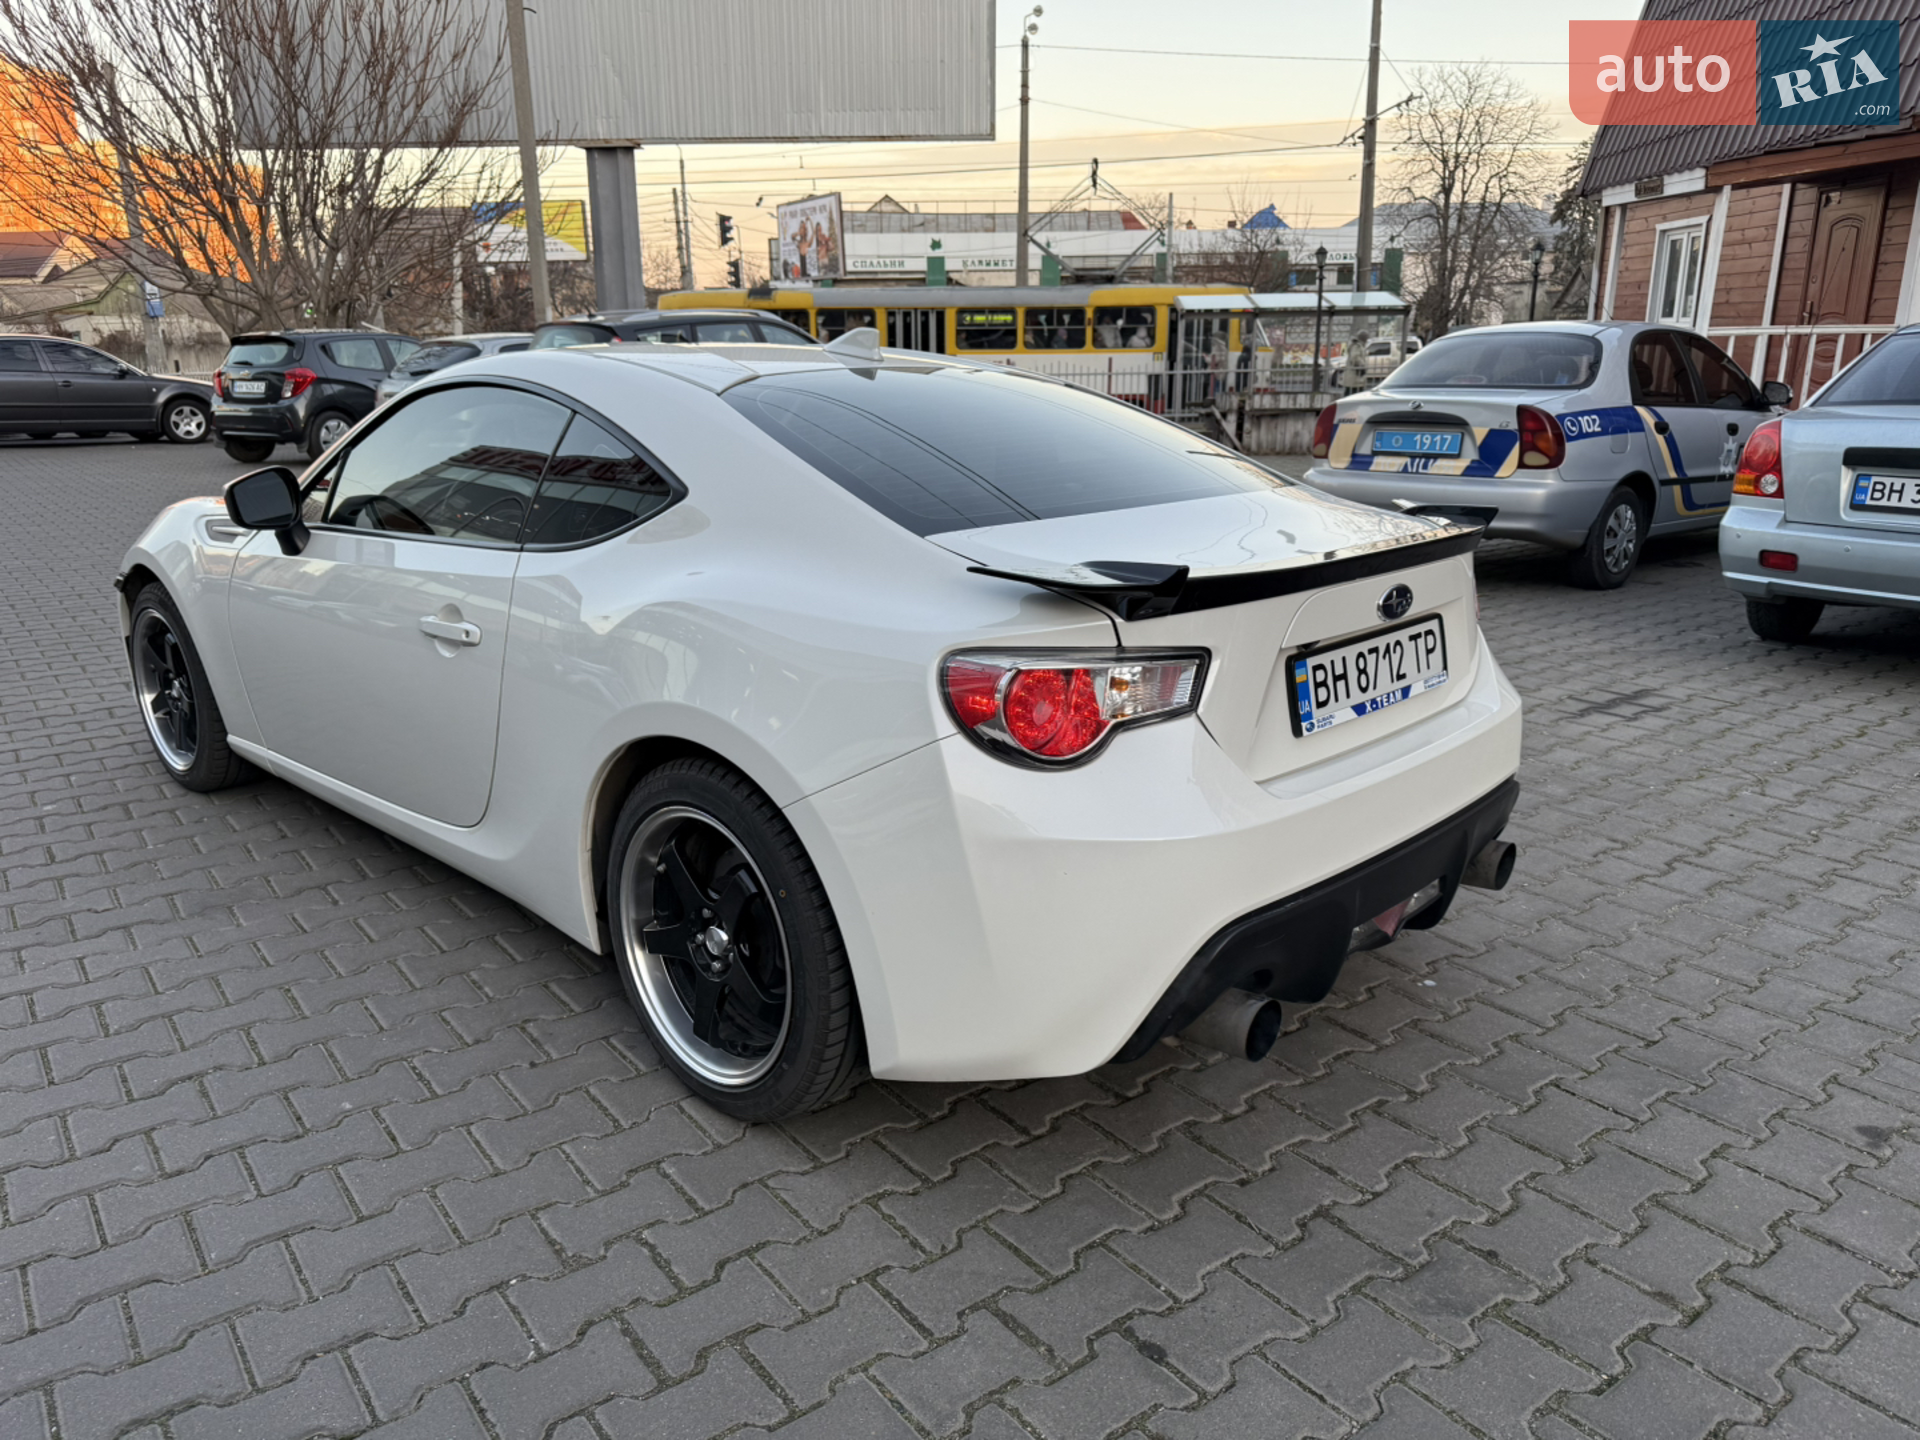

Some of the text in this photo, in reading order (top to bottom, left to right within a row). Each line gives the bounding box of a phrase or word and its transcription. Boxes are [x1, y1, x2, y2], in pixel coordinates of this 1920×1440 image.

[852, 259, 905, 269] СПАЛЬНИ
[1577, 415, 1602, 433] 102
[1413, 433, 1453, 451] 1917
[1869, 481, 1906, 503] BH
[1311, 628, 1437, 710] BH 8712 TP
[1298, 699, 1312, 715] UA
[1364, 688, 1404, 714] X-TEAM
